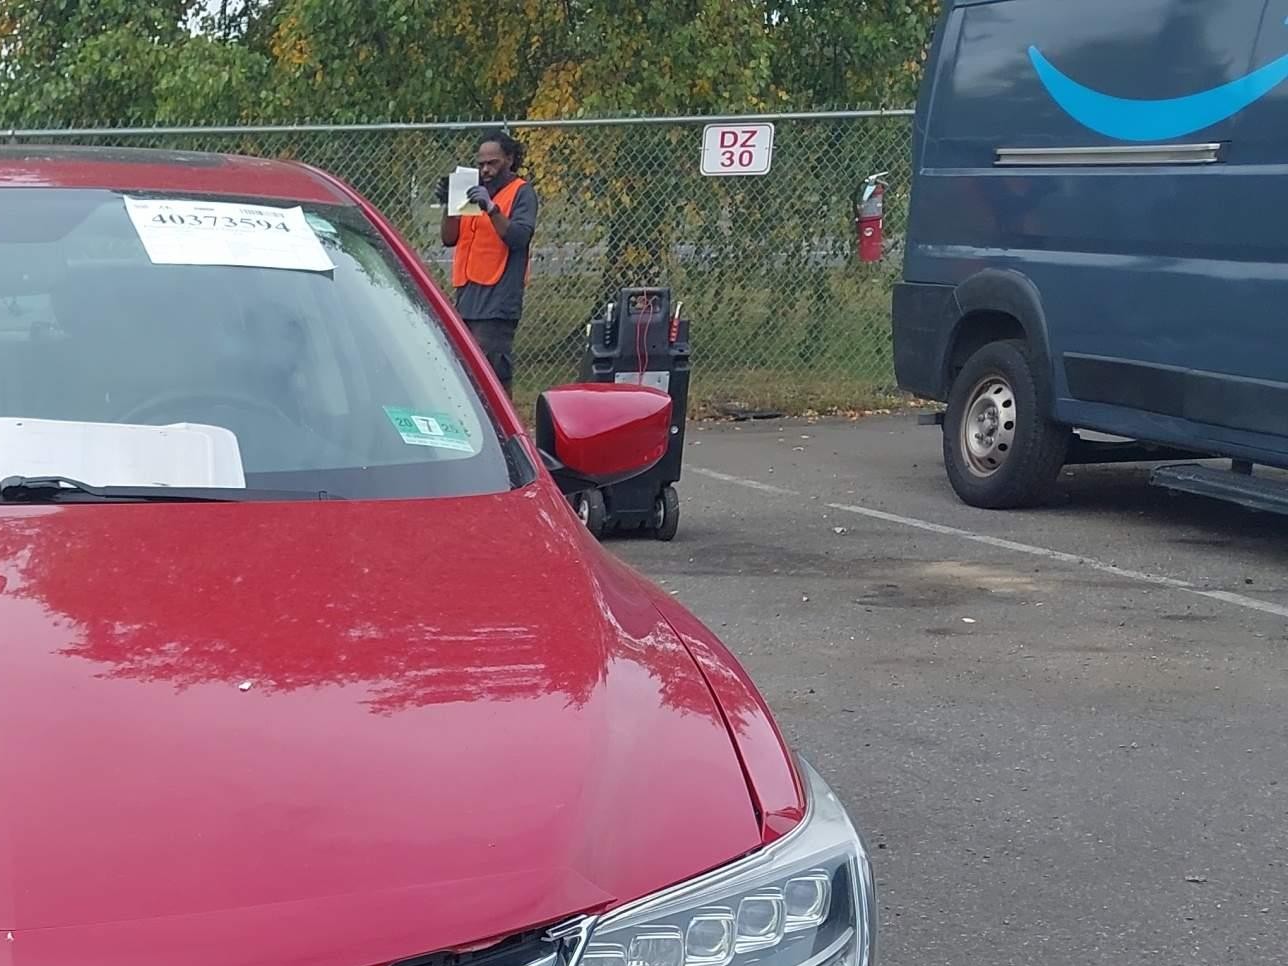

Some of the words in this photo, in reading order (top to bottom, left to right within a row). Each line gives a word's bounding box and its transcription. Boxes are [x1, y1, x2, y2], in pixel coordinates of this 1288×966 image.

[720, 130, 758, 149] DZ
[720, 150, 754, 168] 30
[151, 212, 291, 233] 40373594
